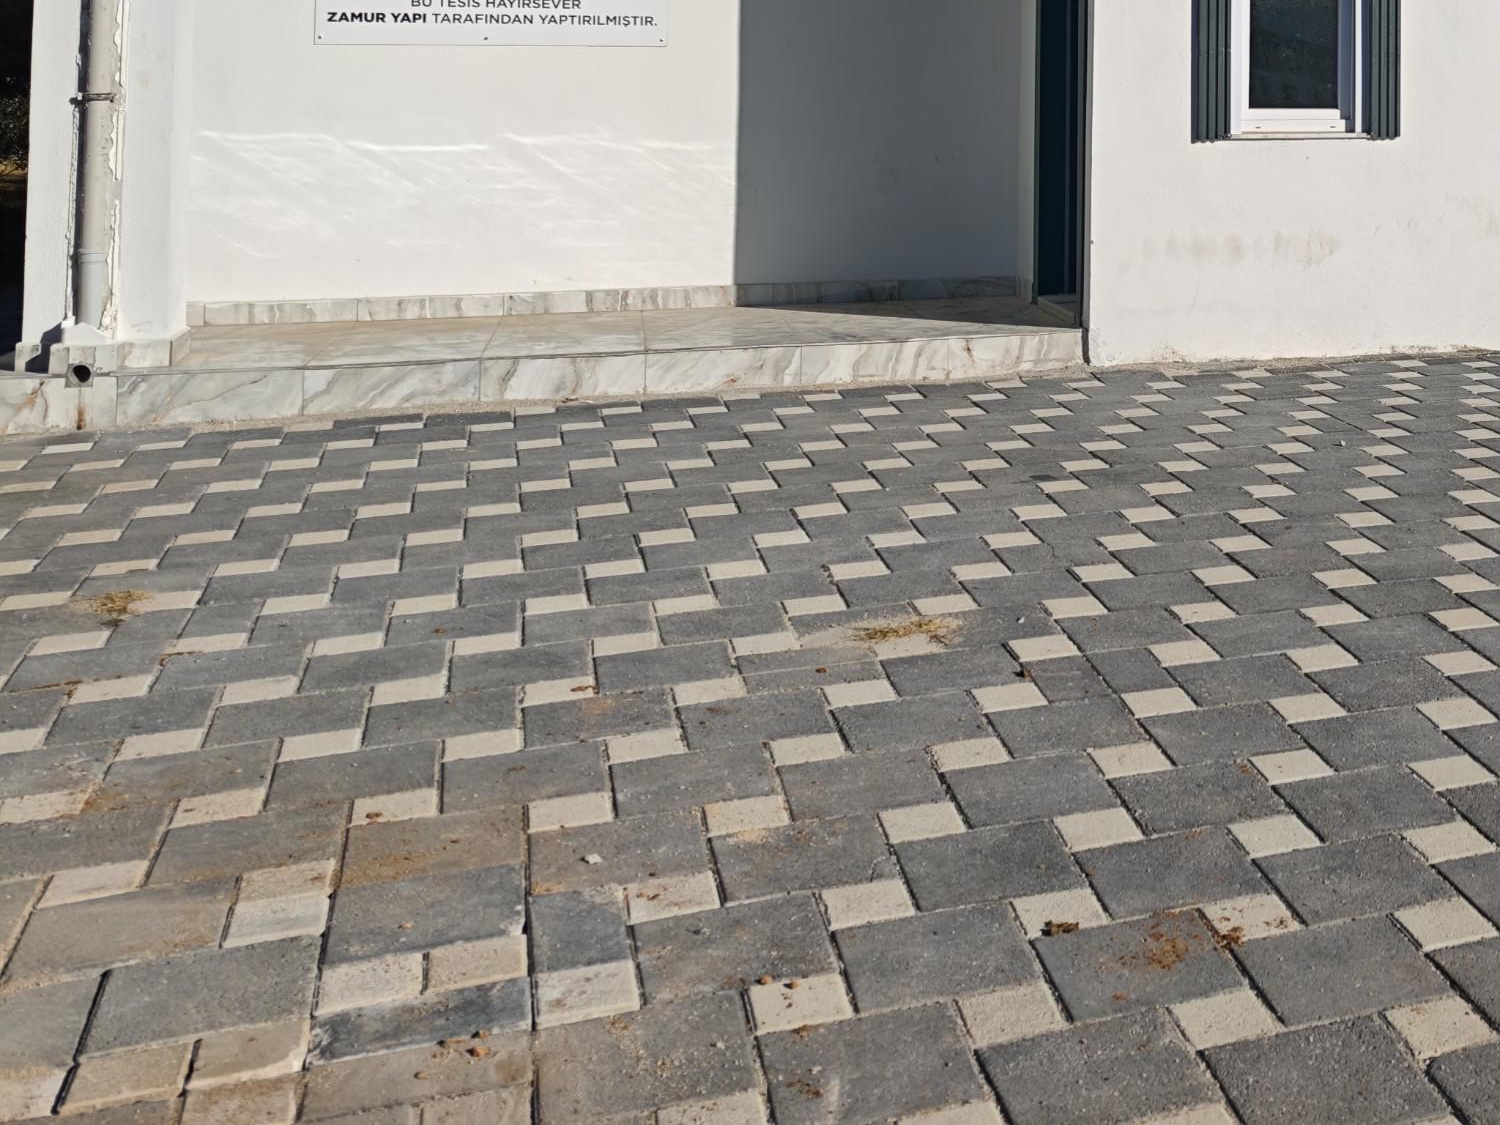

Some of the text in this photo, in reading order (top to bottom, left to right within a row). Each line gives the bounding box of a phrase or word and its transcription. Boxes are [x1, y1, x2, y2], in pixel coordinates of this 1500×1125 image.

[327, 12, 658, 27] ZAMUR YAPI TARAFINDAN YAPTIRILMIŞTIR.
